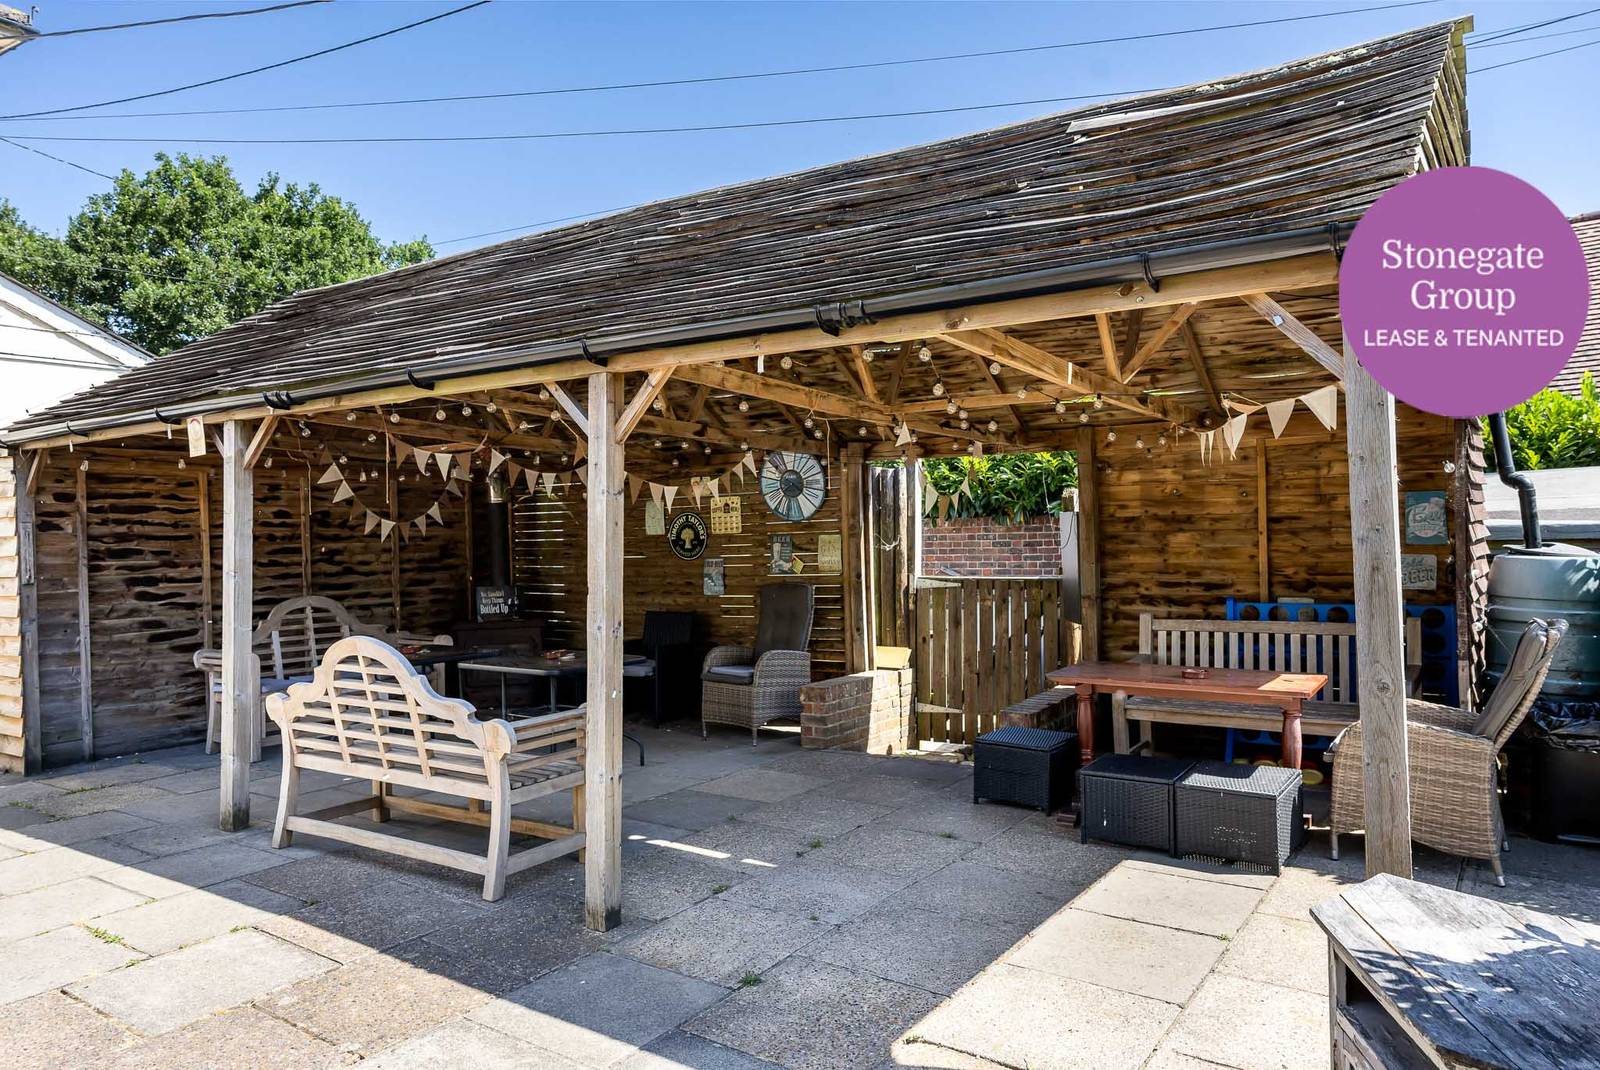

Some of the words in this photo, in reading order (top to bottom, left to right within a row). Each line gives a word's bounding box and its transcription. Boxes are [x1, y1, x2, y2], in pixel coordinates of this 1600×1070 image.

[671, 515, 687, 540] TIMOTHY
[480, 604, 500, 614] Bottled
[500, 603, 509, 614] Up
